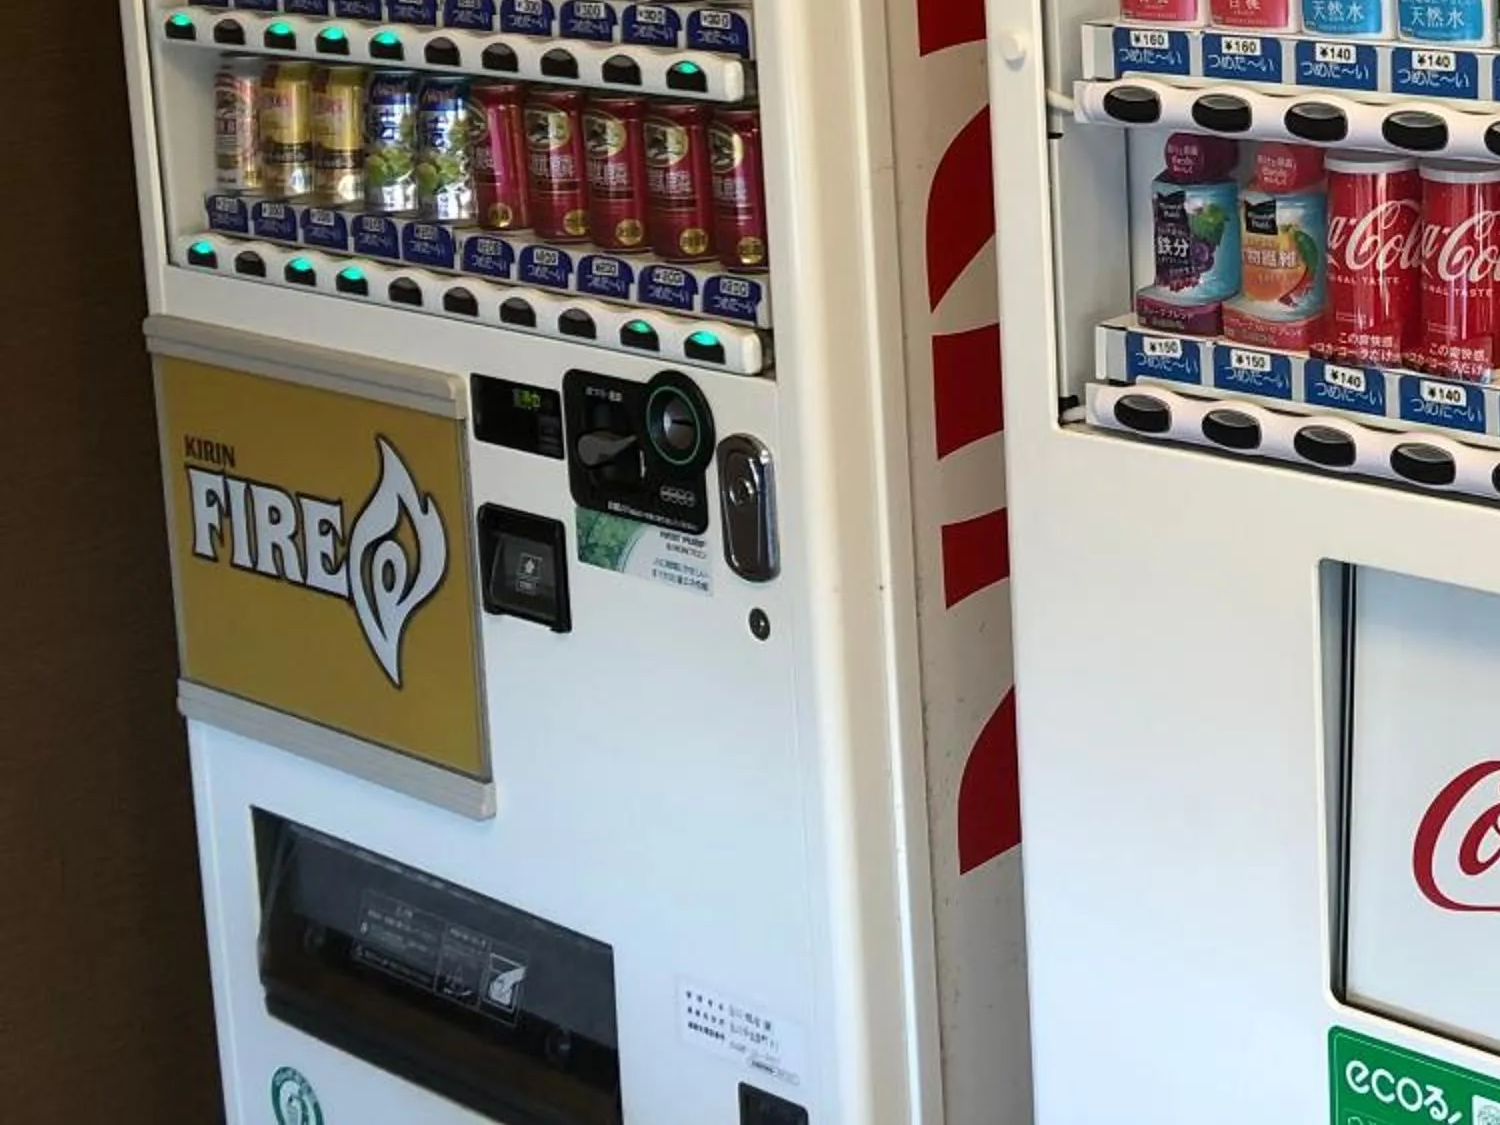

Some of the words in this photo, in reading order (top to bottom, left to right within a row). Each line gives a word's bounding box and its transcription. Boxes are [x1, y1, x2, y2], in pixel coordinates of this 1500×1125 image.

[1410, 5, 1465, 28] 天然水
[1133, 34, 1165, 46] ¥160
[1224, 39, 1258, 54] ¥160
[1320, 47, 1352, 61] ¥140
[1417, 53, 1452, 68] ¥140
[1149, 341, 1179, 355] ¥150
[1235, 355, 1266, 369] ¥150
[1330, 372, 1362, 388] ¥140
[1428, 387, 1462, 403] ¥140
[184, 435, 237, 468] KIRIN
[186, 465, 351, 598] FIRE
